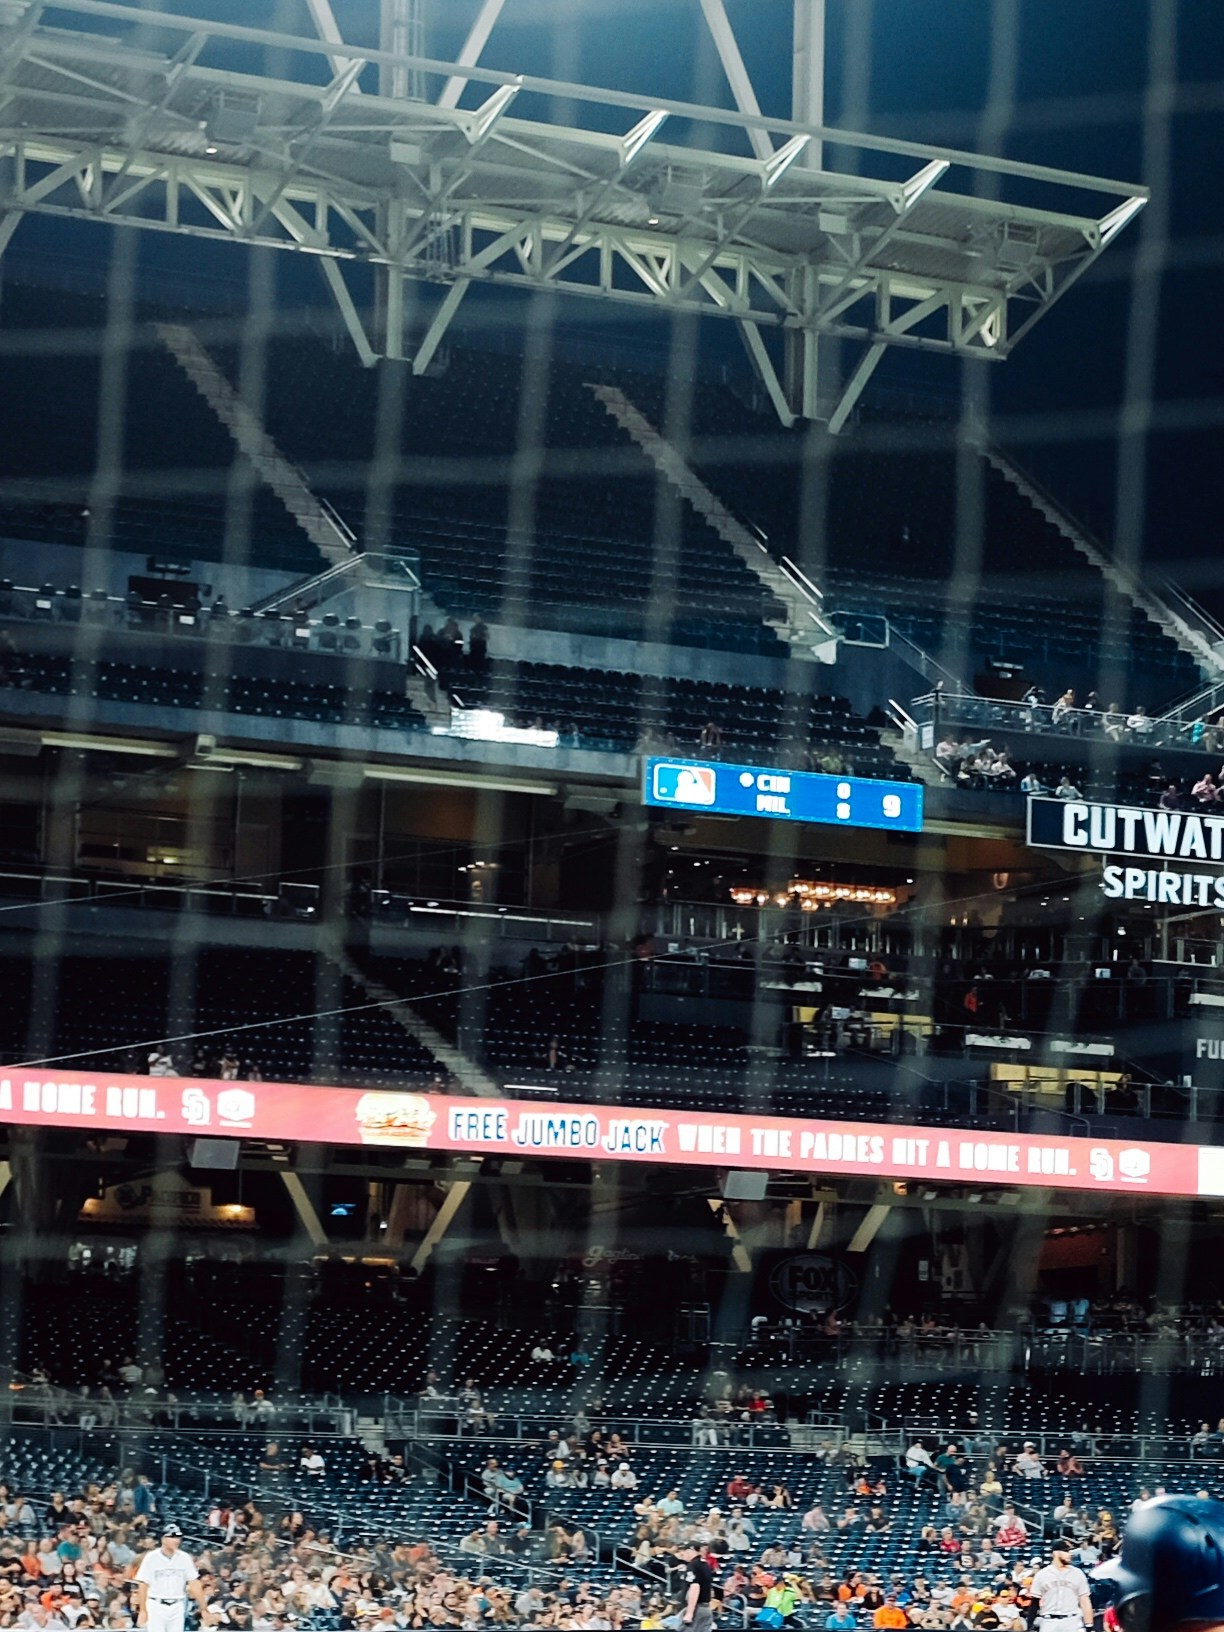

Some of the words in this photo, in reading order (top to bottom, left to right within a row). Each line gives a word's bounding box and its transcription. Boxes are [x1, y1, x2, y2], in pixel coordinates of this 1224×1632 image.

[757, 774, 790, 793] CIN
[757, 795, 790, 814] MIL
[883, 795, 901, 818] 9
[0, 1080, 12, 1110] A
[23, 1081, 96, 1116] HOME
[106, 1087, 165, 1119] RUN.
[452, 1109, 508, 1141] FREE
[514, 1115, 598, 1147] JUMBO
[604, 1121, 667, 1153] JACK
[677, 1124, 740, 1154] WHEN
[749, 1128, 792, 1158] THE
[800, 1130, 884, 1164] PADRES
[892, 1138, 929, 1167] HIT
[936, 1141, 951, 1168] A
[959, 1142, 1019, 1173] HOME
[1027, 1148, 1077, 1175] RUN.
[789, 1265, 837, 1291] FOX
